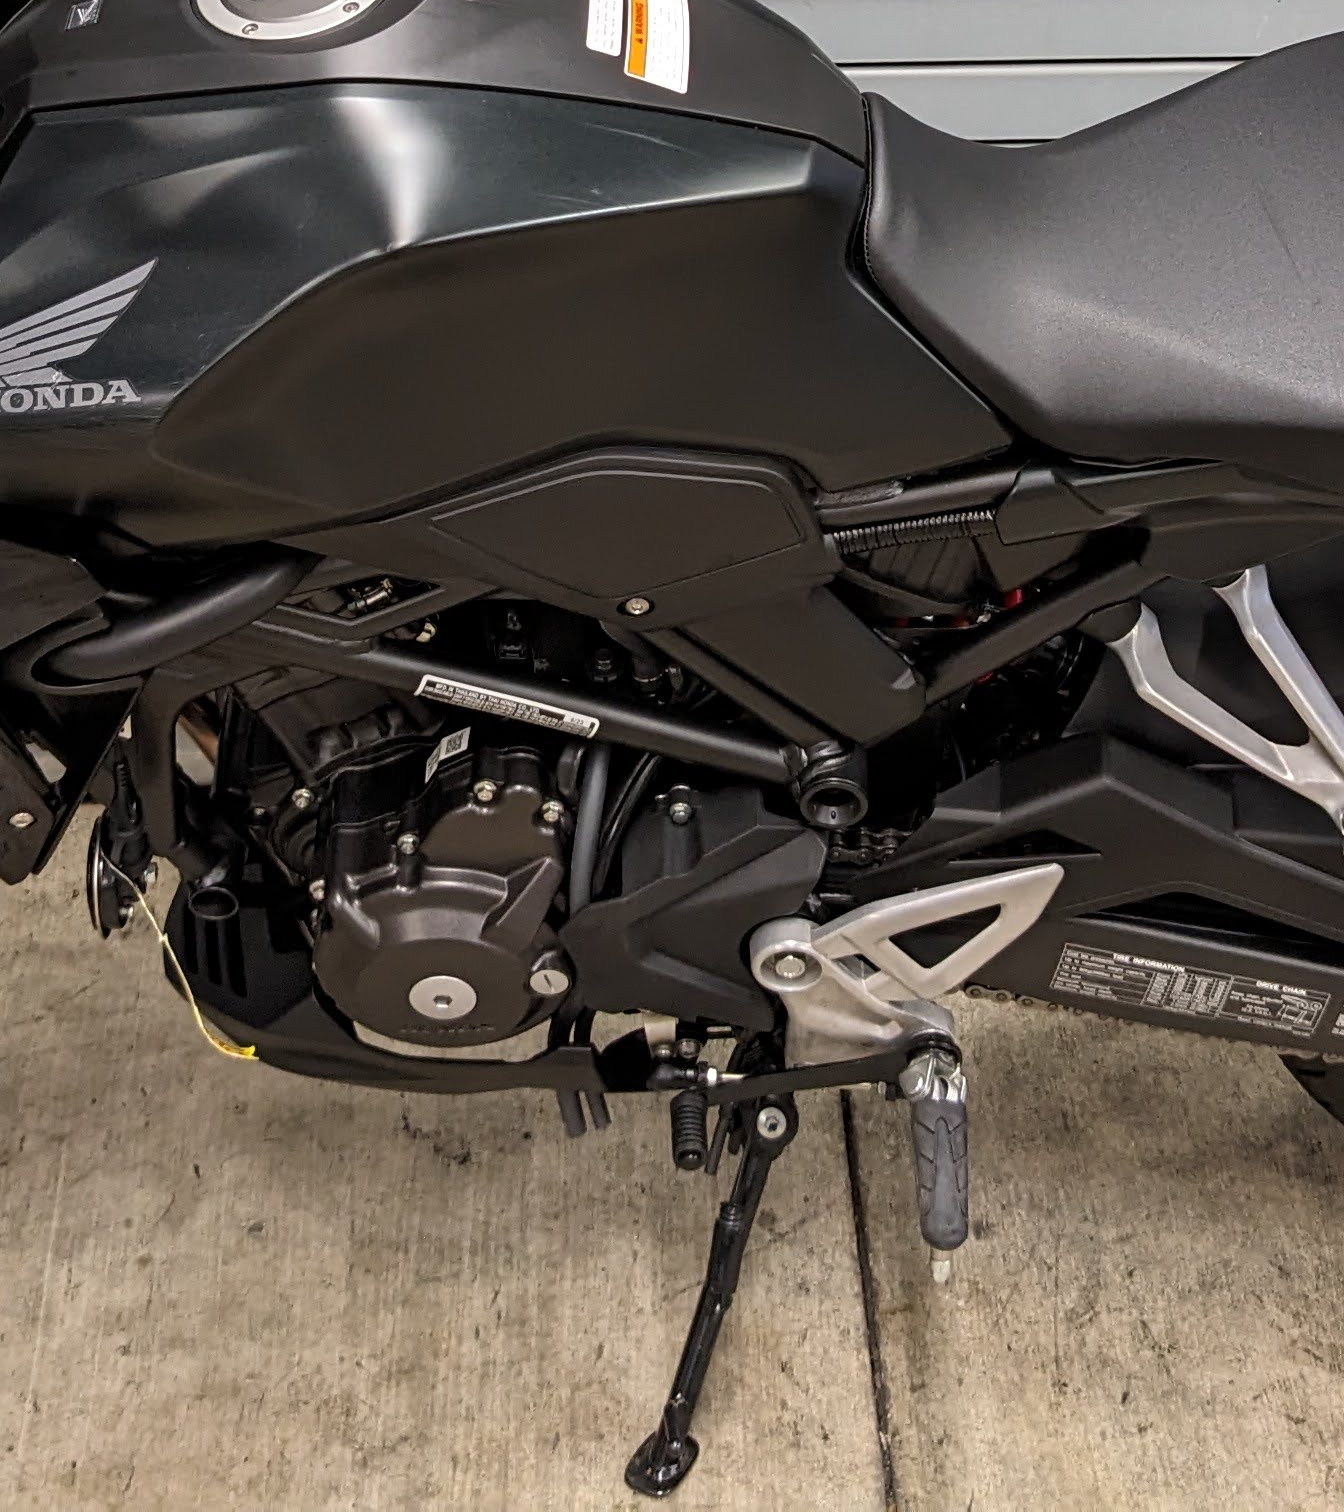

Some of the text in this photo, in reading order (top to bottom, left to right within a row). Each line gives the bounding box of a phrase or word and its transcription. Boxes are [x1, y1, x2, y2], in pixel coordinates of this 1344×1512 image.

[634, 2, 645, 35] WARNING
[1133, 956, 1186, 973] INFORMATION
[1256, 979, 1307, 996] DRIVE CHAIN
